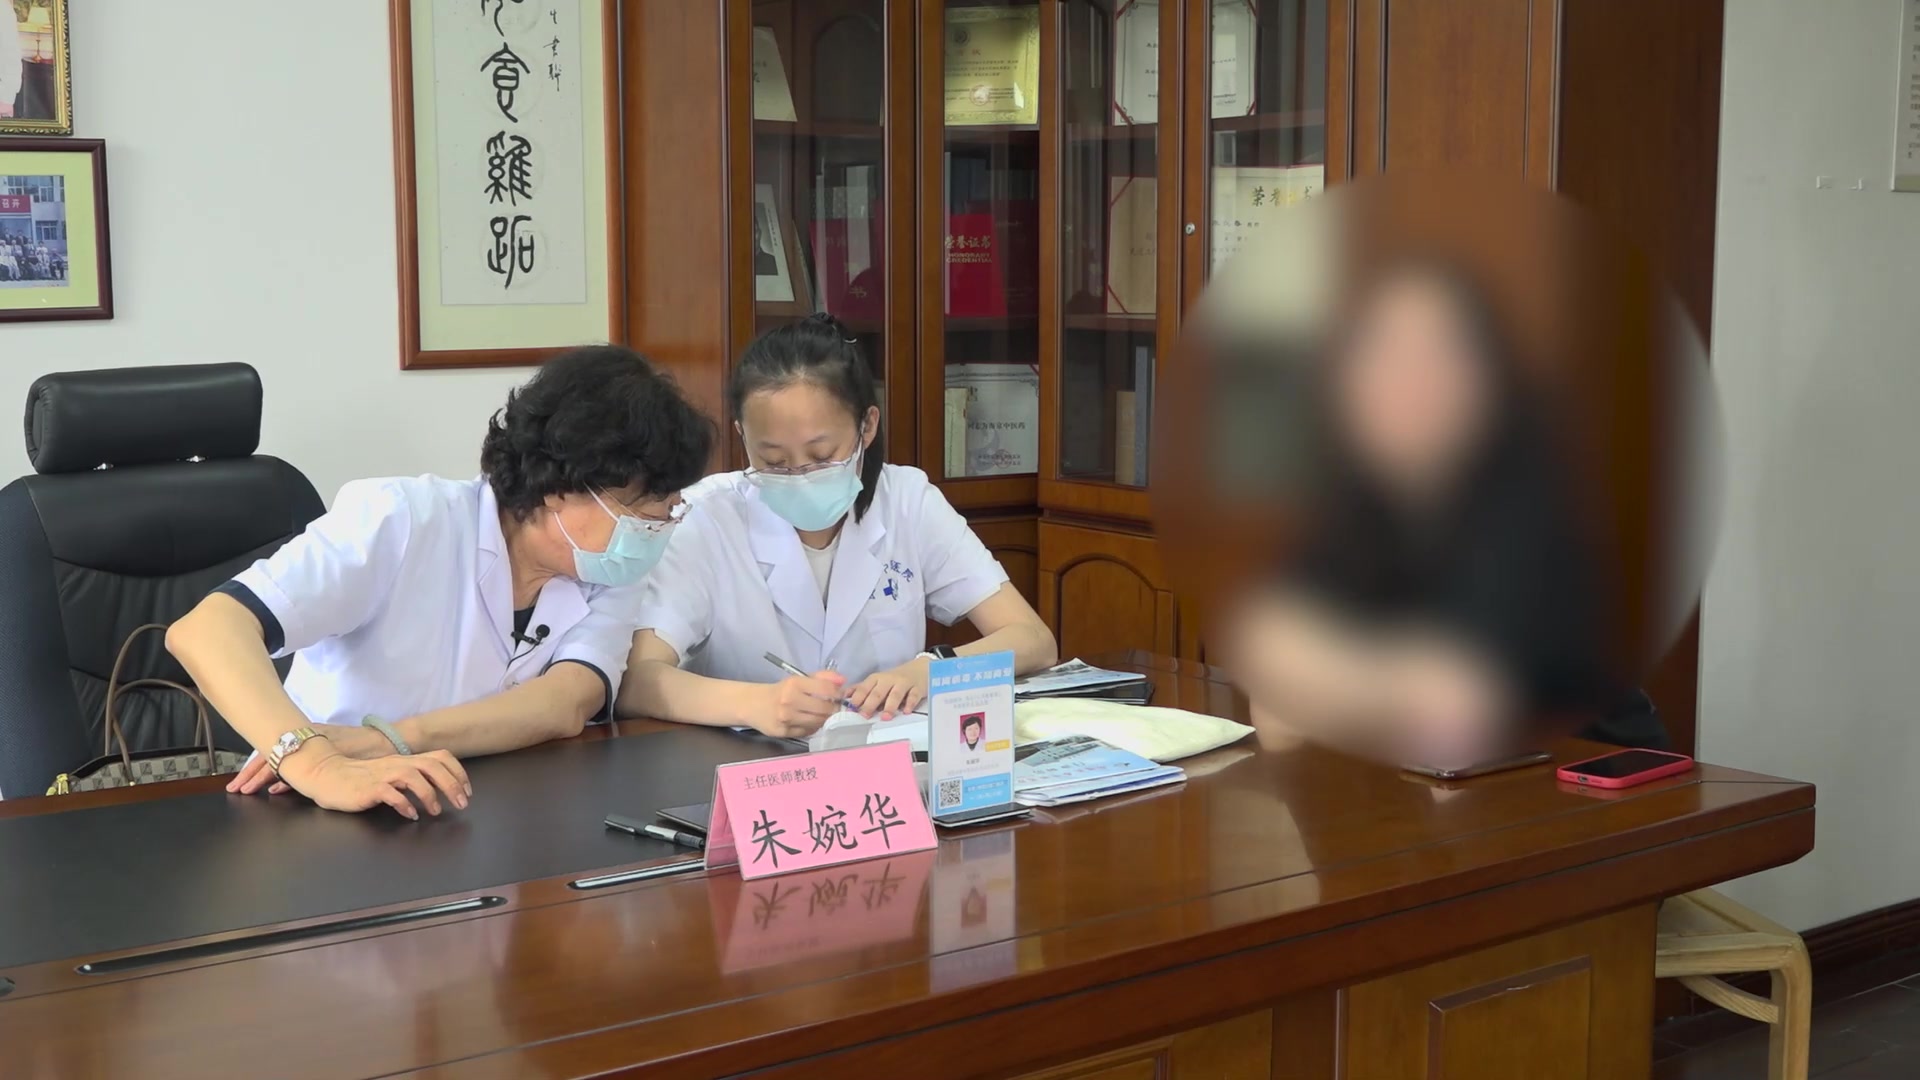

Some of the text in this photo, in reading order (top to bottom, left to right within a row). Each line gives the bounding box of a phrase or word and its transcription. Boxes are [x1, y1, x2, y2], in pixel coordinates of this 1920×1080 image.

[744, 767, 819, 790] 主任医师教授
[752, 793, 906, 869] 朱婉华
